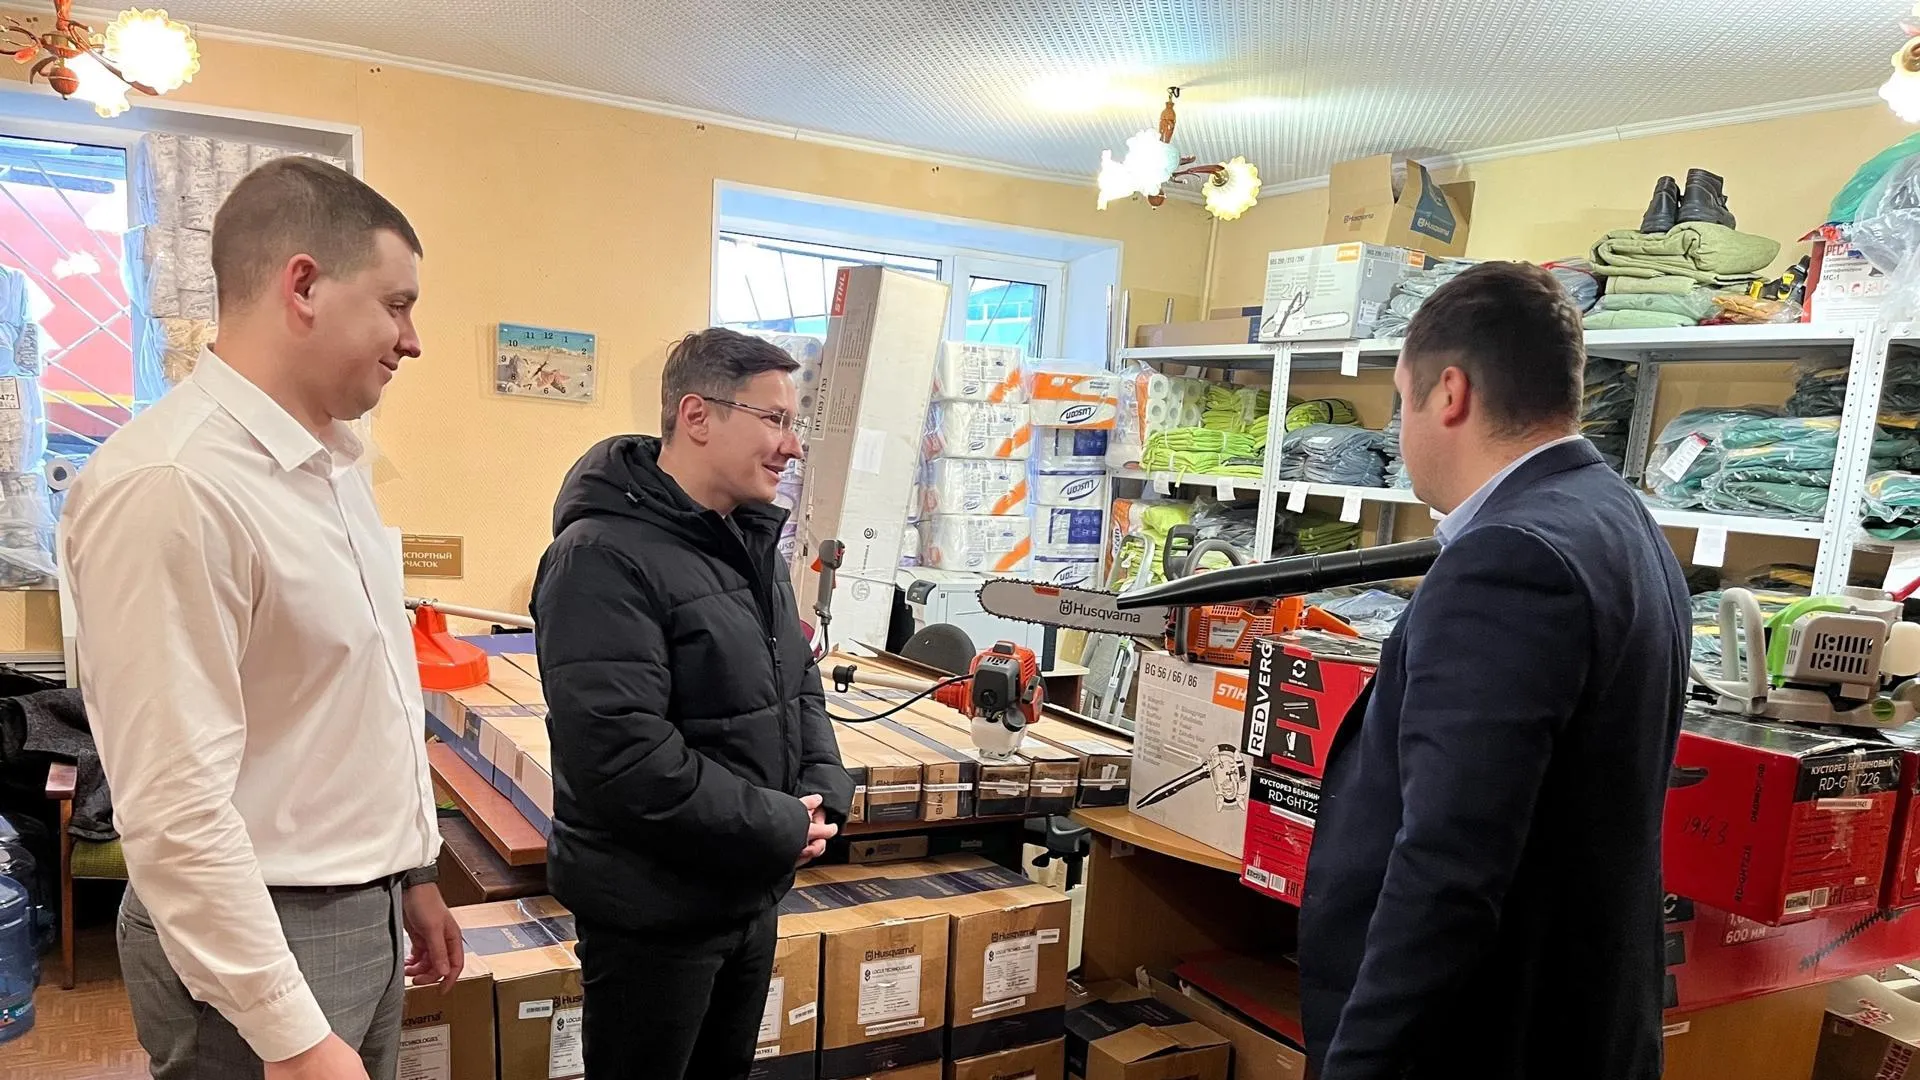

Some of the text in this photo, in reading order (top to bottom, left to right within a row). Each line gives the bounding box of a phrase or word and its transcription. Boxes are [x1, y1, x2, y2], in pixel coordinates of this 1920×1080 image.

[835, 271, 847, 313] STIHL
[508, 339, 518, 347] 10
[526, 331, 535, 339] 11
[544, 331, 553, 339] 12
[587, 364, 592, 372] 3
[1065, 407, 1092, 419] Luscan
[1066, 479, 1094, 495] Luscan
[1073, 603, 1141, 623] Husqvarna
[1144, 662, 1156, 676] BG
[1157, 666, 1167, 679] 56
[1172, 670, 1182, 684] 66
[1187, 674, 1198, 688] 86
[1216, 683, 1247, 700] STIH
[1811, 762, 1847, 775] КУСТОРЕЗ
[1259, 777, 1320, 800] КУСТОРЕЗ БЕНЗИН
[1725, 928, 1749, 944] 600
[874, 946, 916, 959] Husqvarna
[402, 1012, 441, 1028] qvarna
